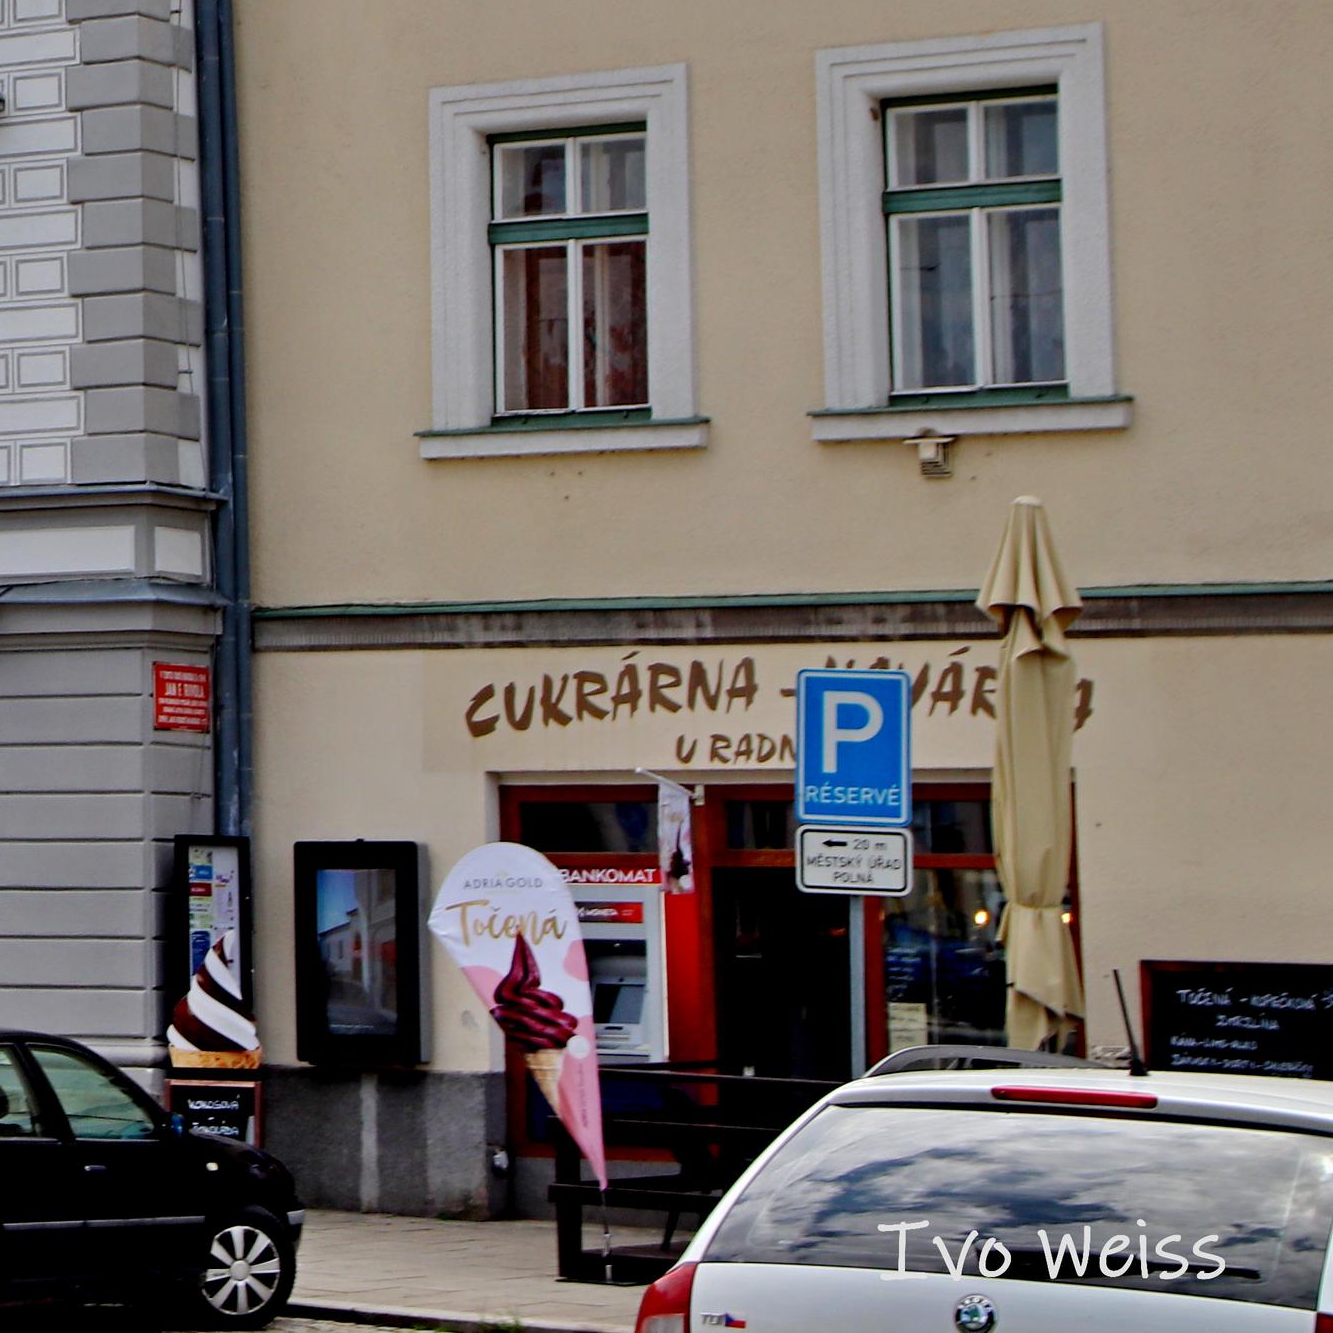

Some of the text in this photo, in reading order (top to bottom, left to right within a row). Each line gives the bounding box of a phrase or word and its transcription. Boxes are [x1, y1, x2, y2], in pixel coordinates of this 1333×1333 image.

[465, 651, 758, 738] CUKRÁRNA
[822, 691, 884, 774] P
[676, 734, 697, 764] U
[805, 781, 901, 806] RÉSERVÉ
[853, 838, 870, 850] 20
[806, 852, 902, 870] MĚSTSKÝ ÚŘAD
[464, 876, 543, 890] ADRIA GOLD
[561, 868, 657, 884] BANKOMAT
[833, 869, 873, 883] POLNÁ
[445, 899, 569, 948] Točená
